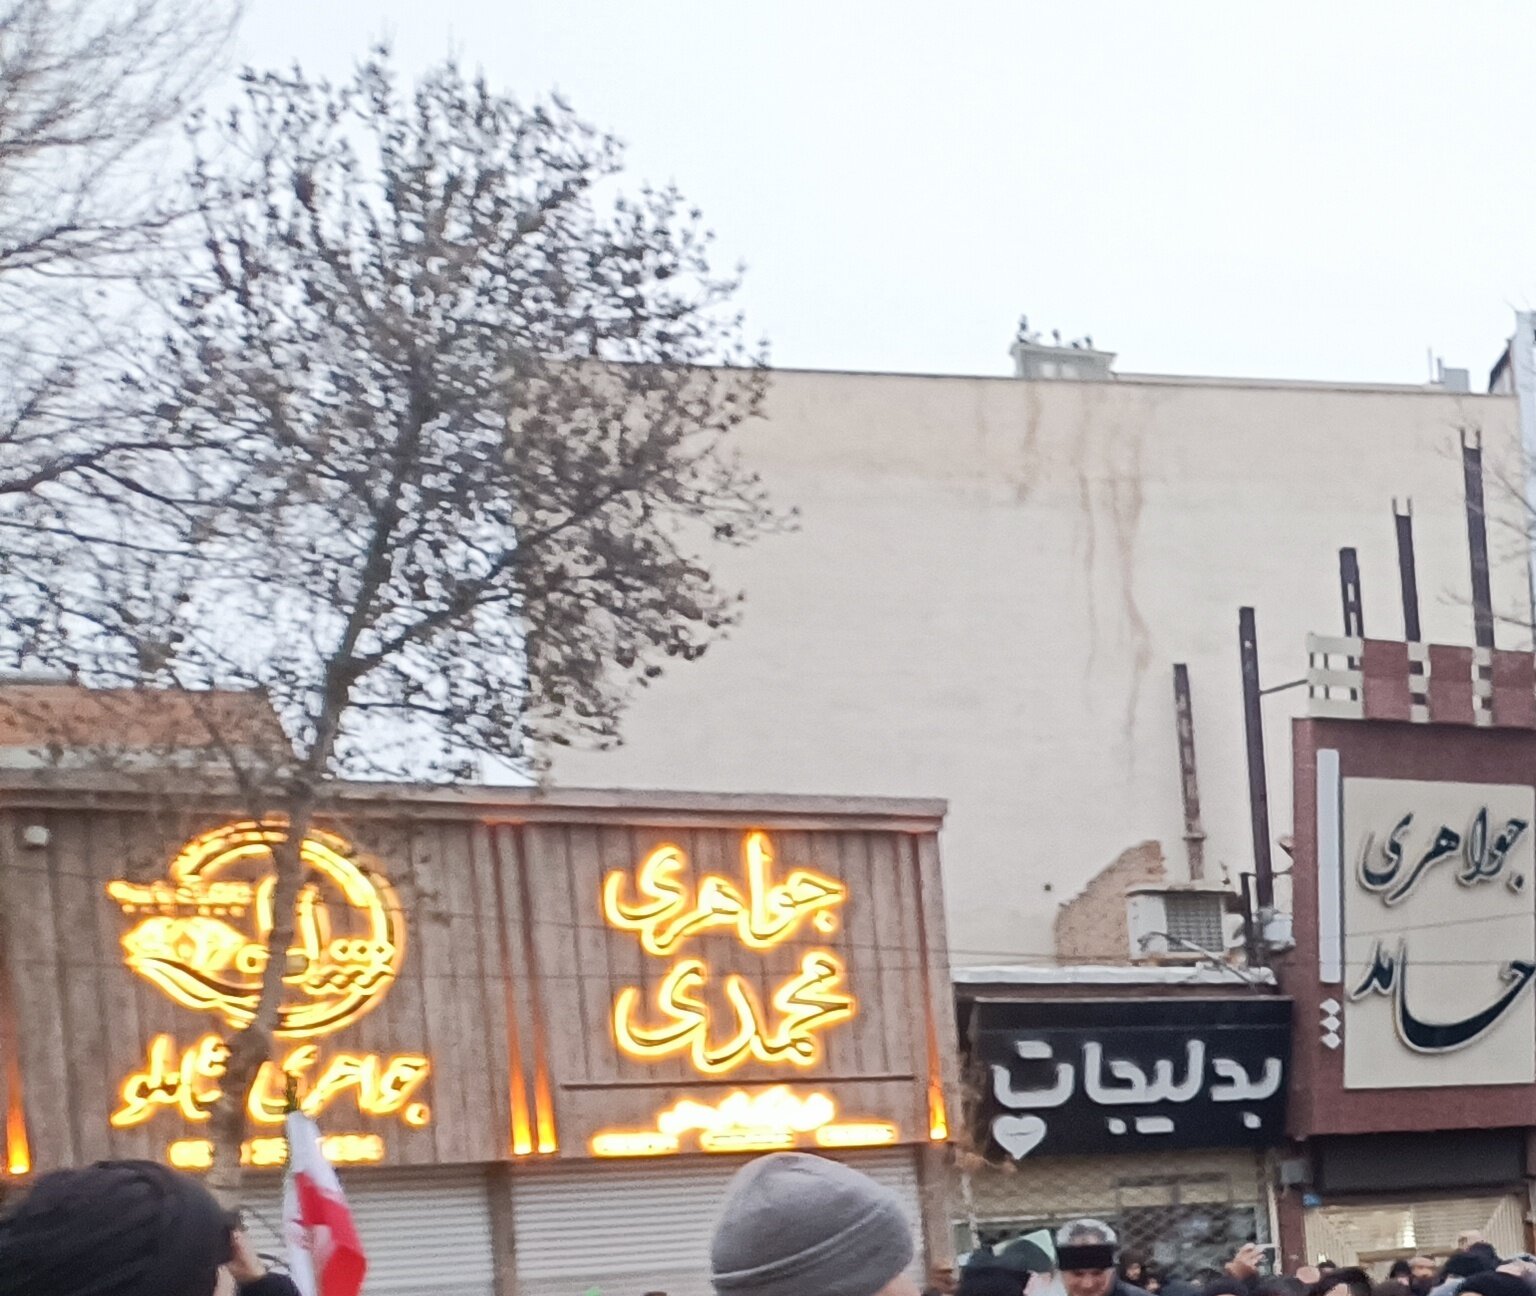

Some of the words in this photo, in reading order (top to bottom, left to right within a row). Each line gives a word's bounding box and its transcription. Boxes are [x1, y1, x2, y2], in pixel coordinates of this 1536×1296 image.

[602, 829, 848, 957] جواهری
[1356, 803, 1530, 908] جواهری
[611, 950, 858, 1075] محمدی
[990, 1038, 1283, 1136] بدلیجات
